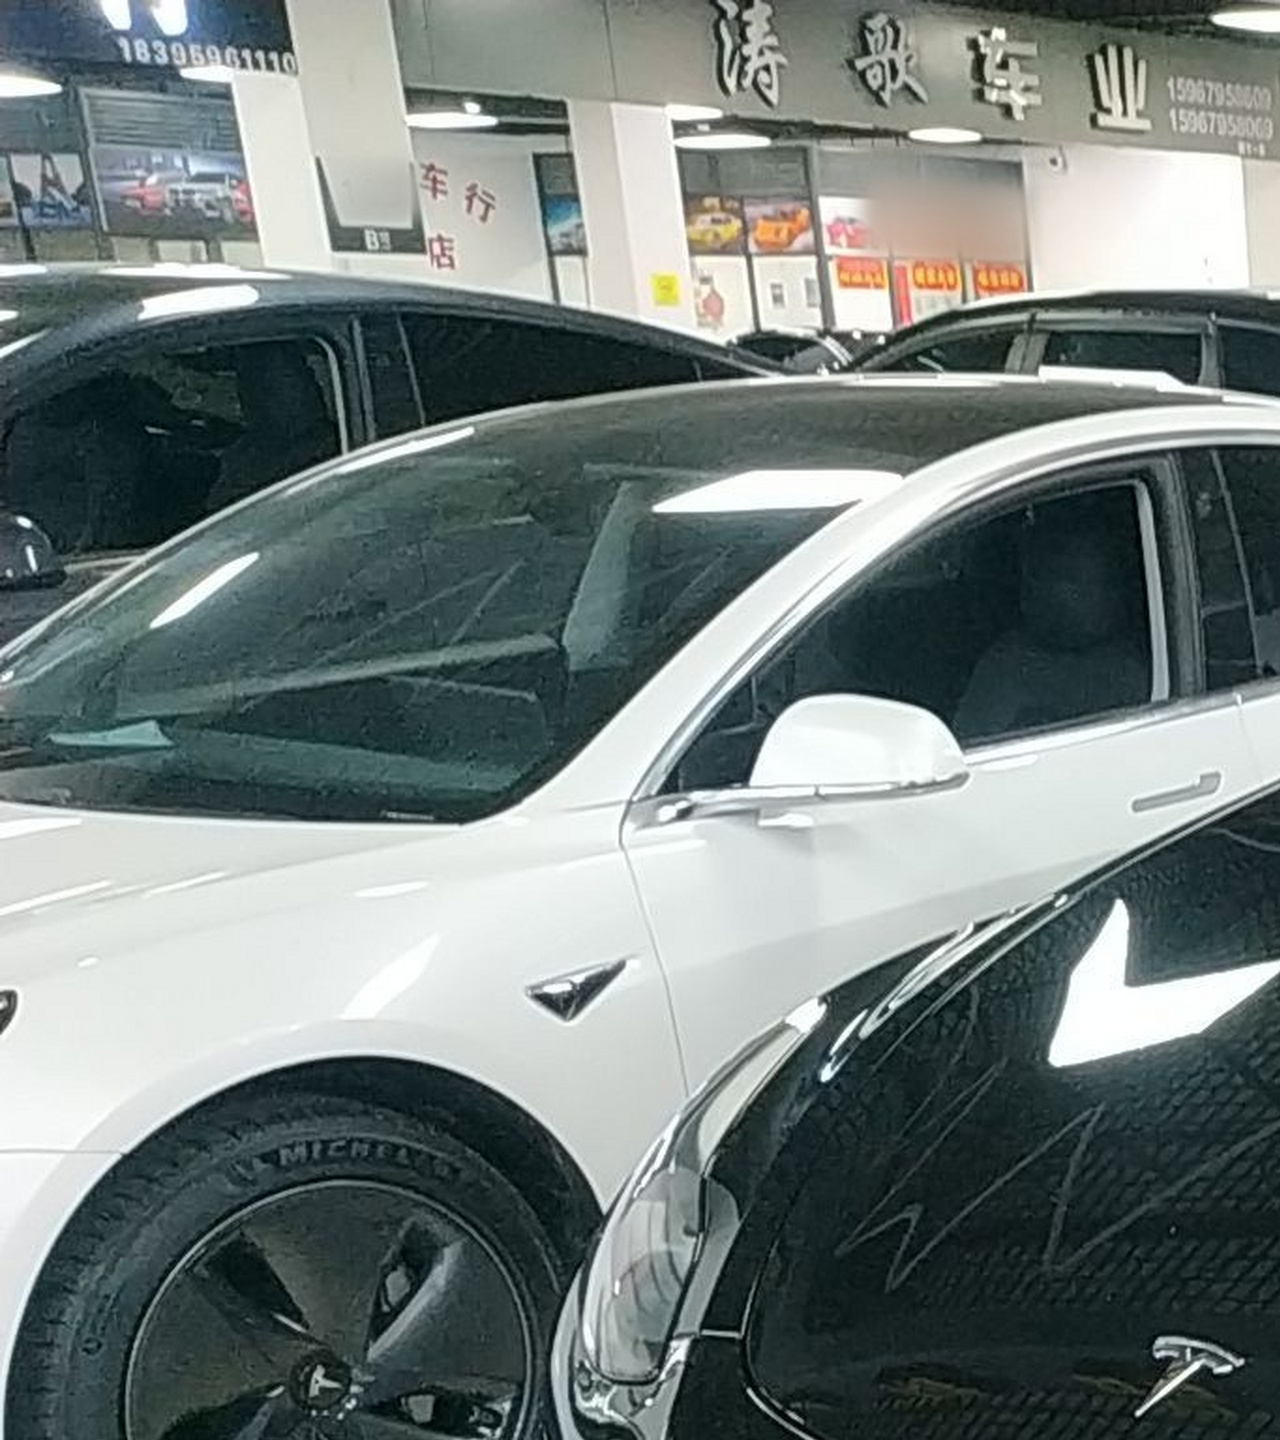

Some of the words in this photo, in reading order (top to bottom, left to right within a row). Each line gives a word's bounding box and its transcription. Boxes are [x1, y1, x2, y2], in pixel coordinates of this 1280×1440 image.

[716, 0, 1152, 131] 涛歌车业
[420, 162, 496, 223] 车行
[428, 233, 455, 270] 店
